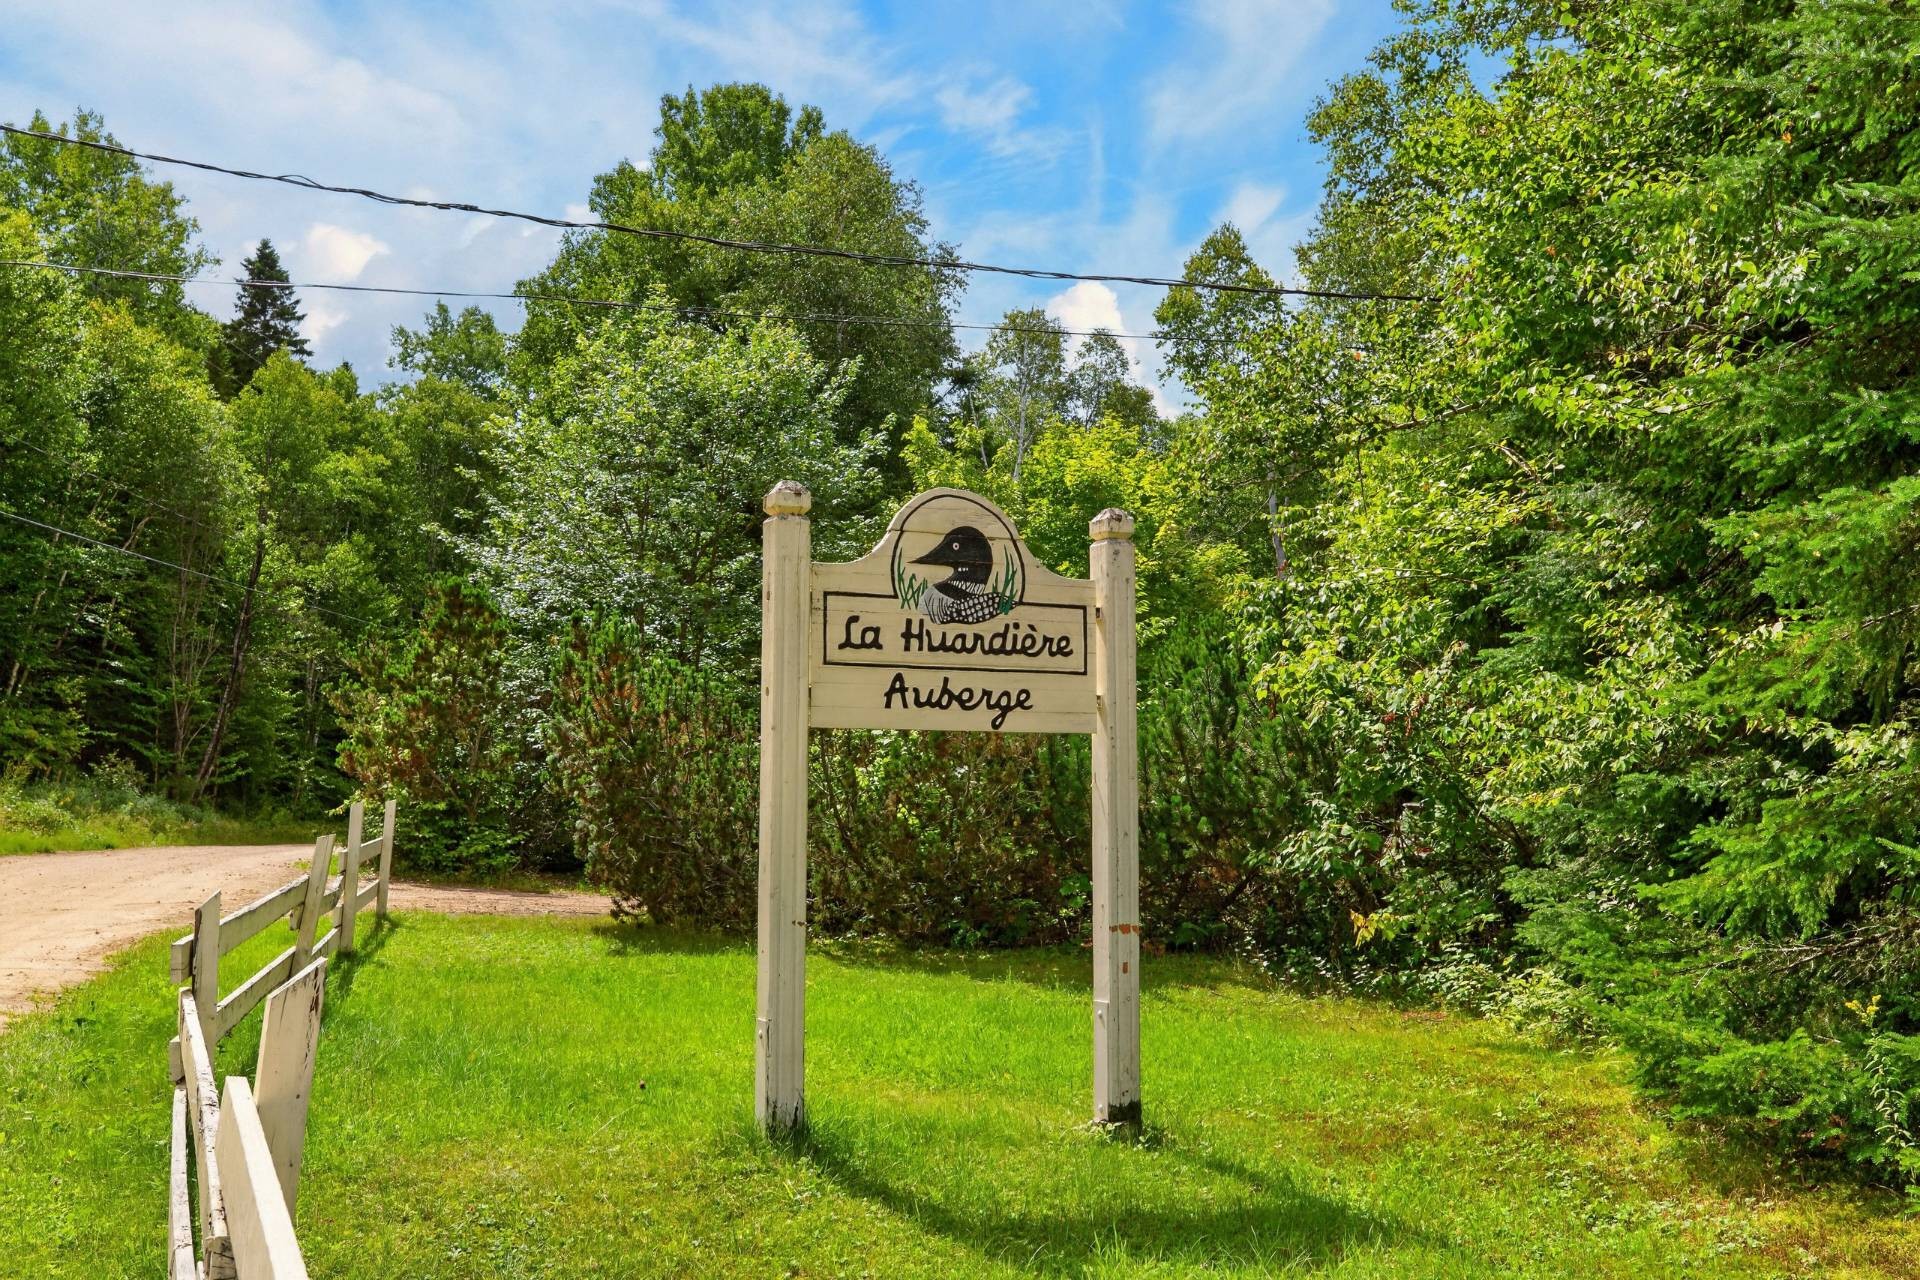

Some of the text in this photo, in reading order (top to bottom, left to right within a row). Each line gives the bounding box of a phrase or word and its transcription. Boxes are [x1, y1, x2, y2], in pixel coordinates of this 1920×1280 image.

[838, 615, 1073, 657] La Huardière
[884, 672, 1033, 730] Auberge
